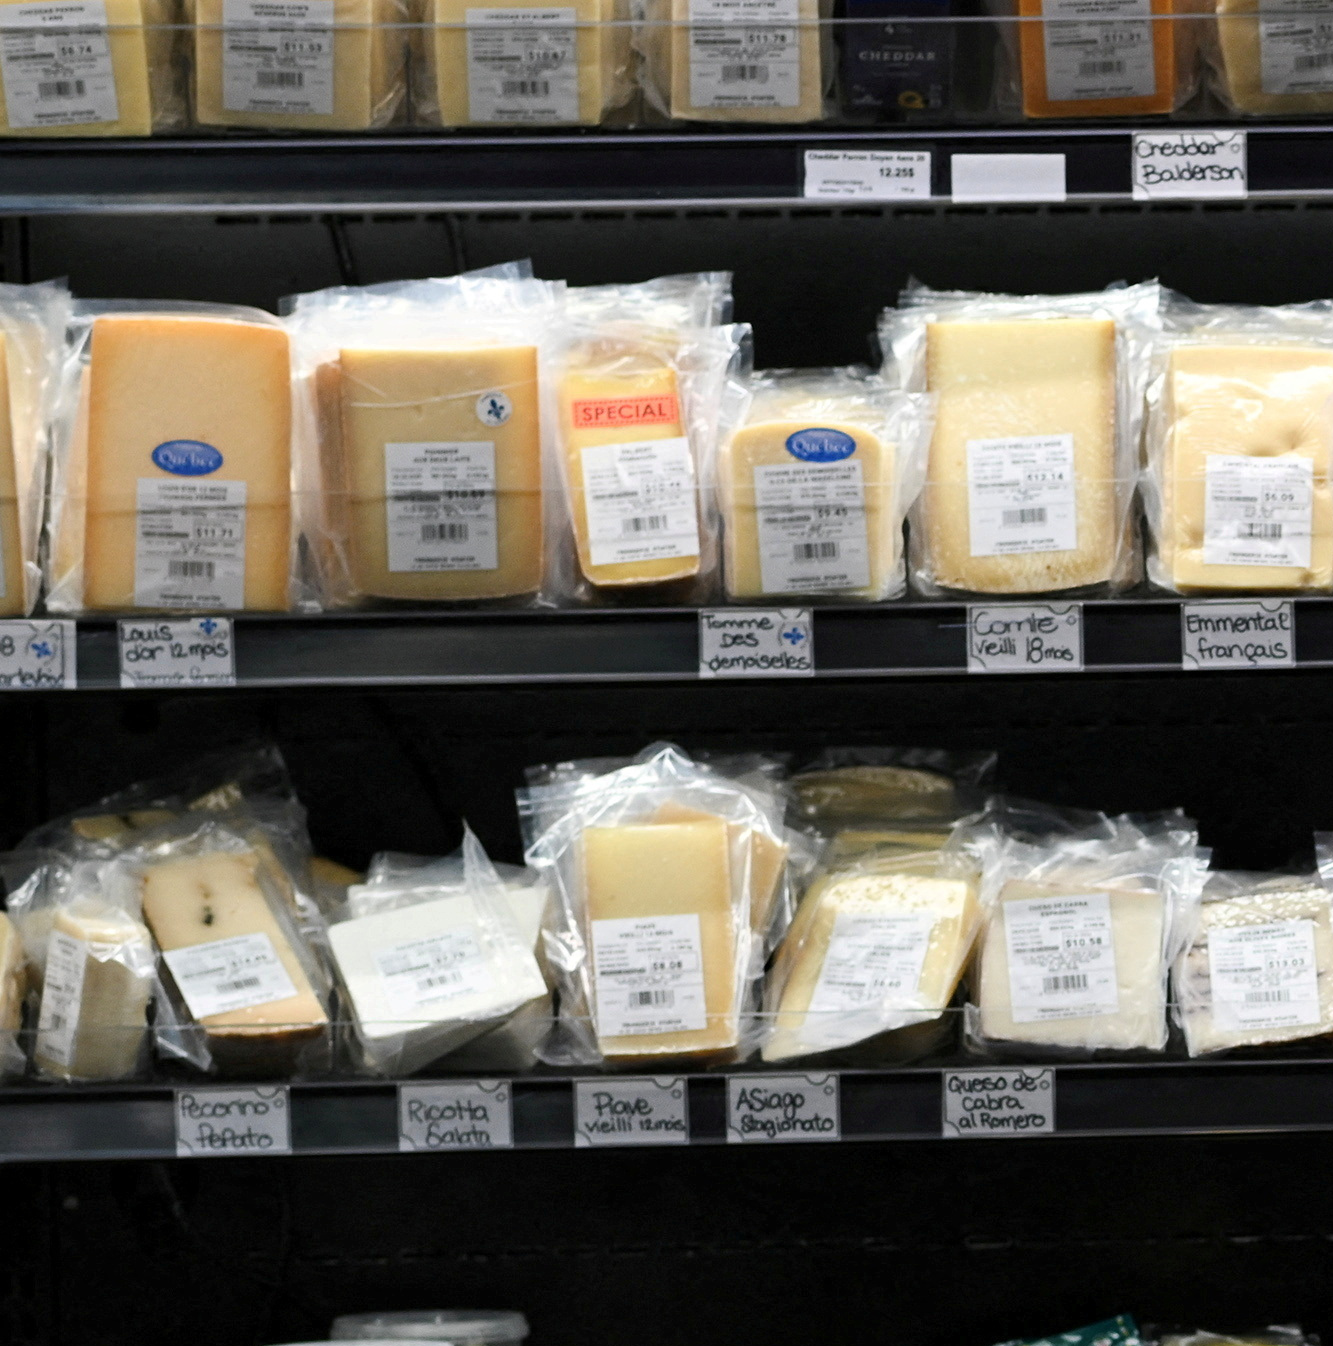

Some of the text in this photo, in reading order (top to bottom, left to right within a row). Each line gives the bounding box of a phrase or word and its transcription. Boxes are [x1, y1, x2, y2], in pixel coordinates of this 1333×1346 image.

[858, 50, 936, 62] CHEDDAR
[878, 167, 914, 179] 12.25$
[1142, 162, 1244, 184] Balderson
[582, 402, 669, 423] SPECIAL
[701, 613, 774, 632] Tomme
[1186, 611, 1292, 634] Emmental
[121, 625, 173, 642] Louis
[169, 643, 188, 658] 12
[1025, 638, 1075, 663] 18 mois
[1197, 637, 1290, 666] français
[707, 651, 812, 673] demoiselles
[948, 1072, 1038, 1093] Queso de
[408, 1099, 490, 1123] Ricotta
[592, 1092, 654, 1117] Piave
[961, 1093, 1025, 1112] Cabra
[958, 1111, 1046, 1132] al Romero
